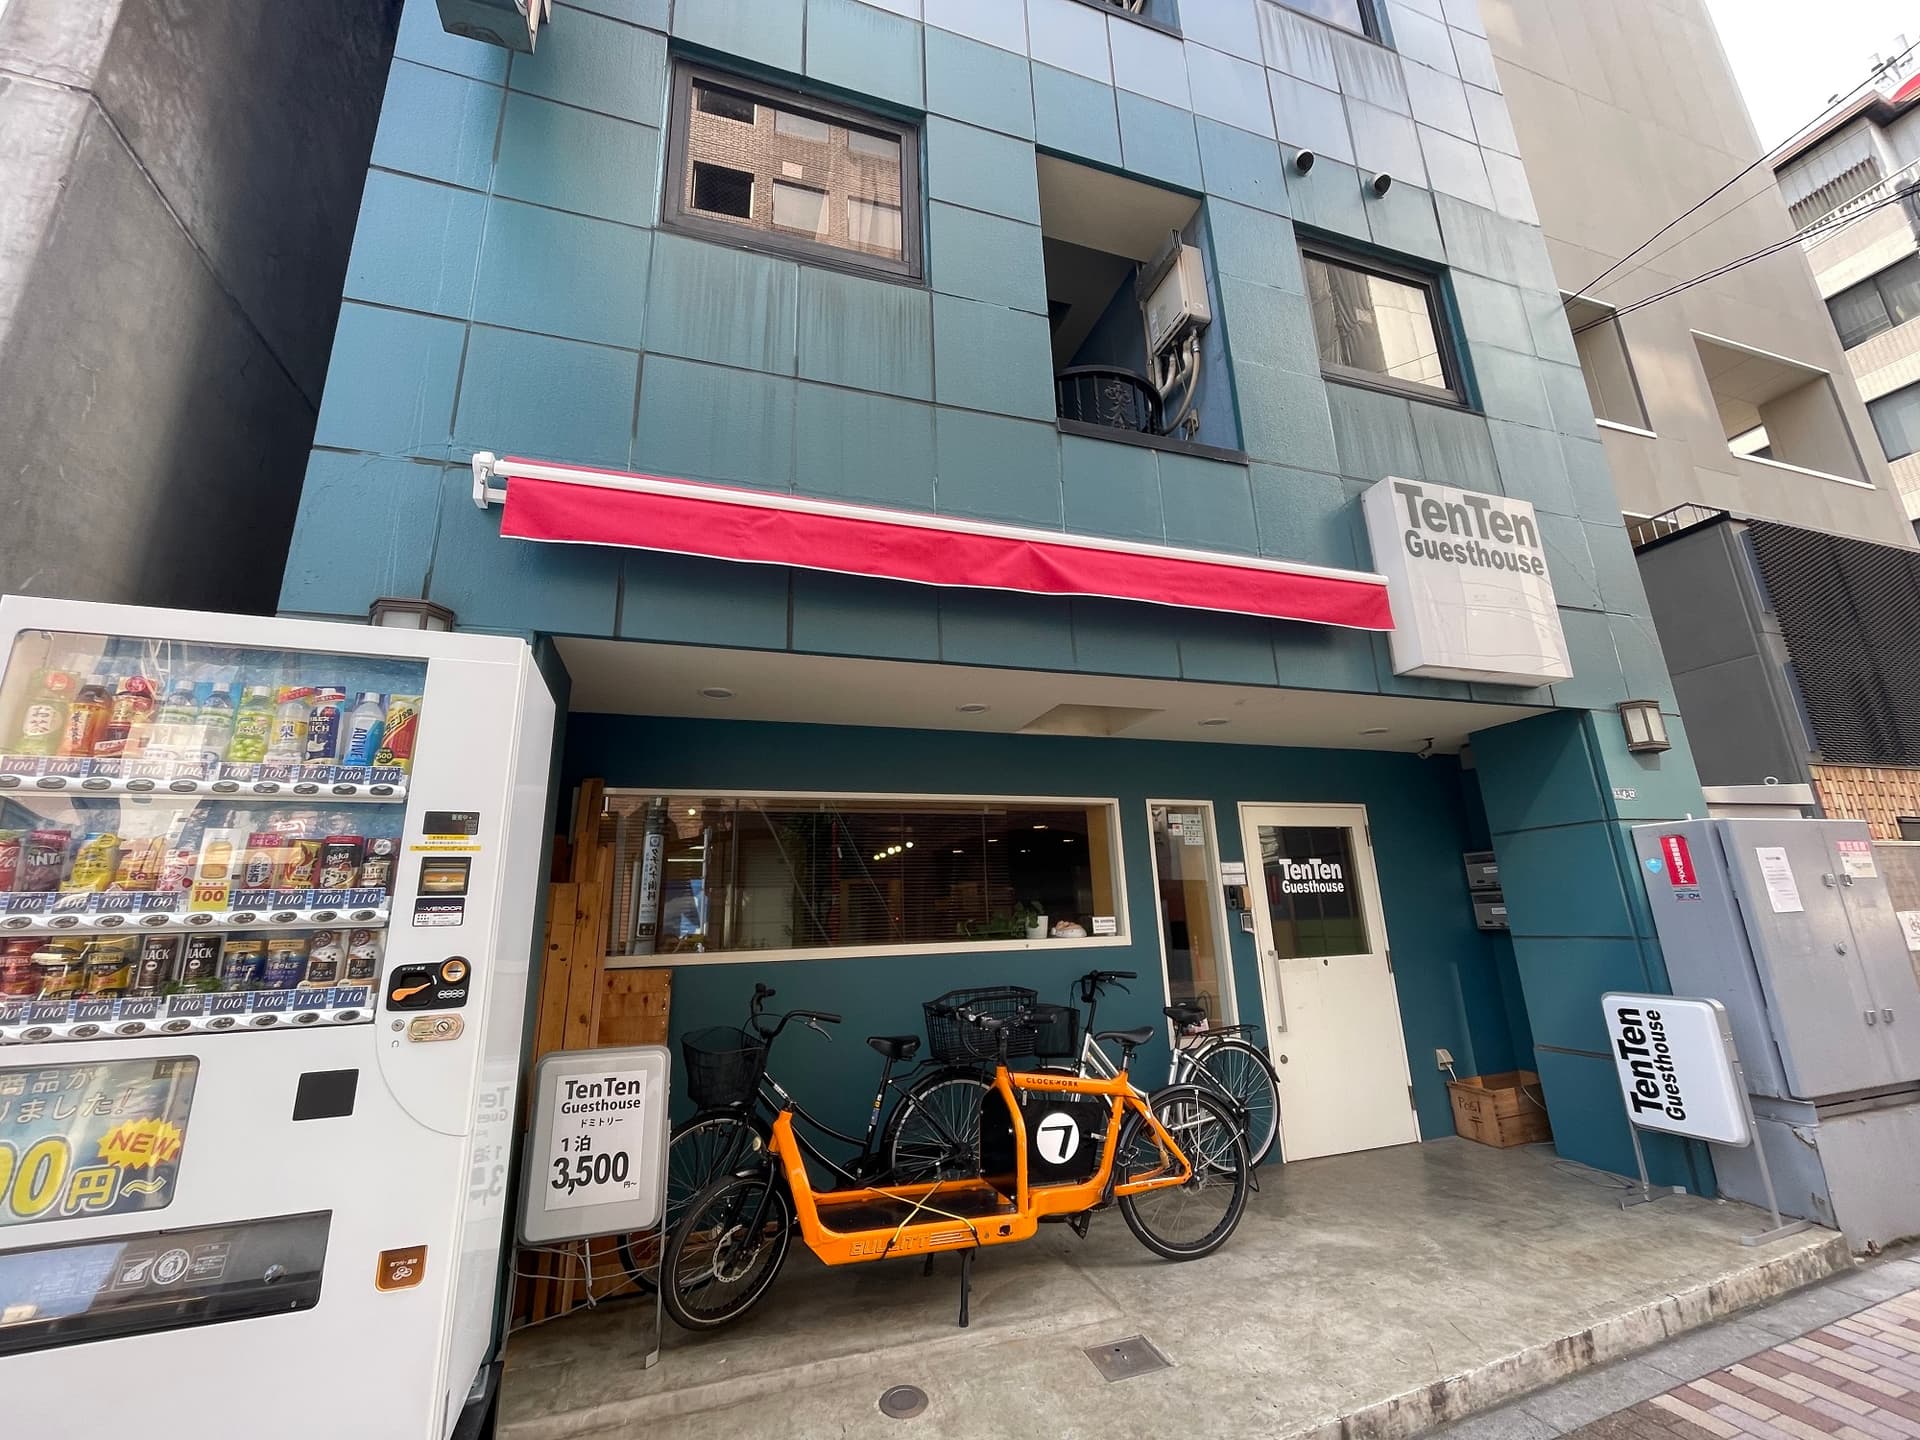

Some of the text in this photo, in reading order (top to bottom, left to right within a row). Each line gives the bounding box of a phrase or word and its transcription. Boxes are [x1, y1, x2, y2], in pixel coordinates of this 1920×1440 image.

[1394, 482, 1538, 548] TenTen
[1405, 530, 1545, 576] Guesthouse
[5, 761, 35, 771] 100
[48, 762, 78, 773] 100
[92, 763, 121, 774] 100
[223, 767, 250, 778] 100
[262, 768, 288, 779] 100
[301, 769, 327, 780] 110
[337, 770, 362, 781] 100
[373, 771, 398, 781] 110
[1279, 858, 1343, 880] TenTen
[1282, 880, 1345, 894] Guesthouse
[144, 895, 173, 908] 100
[194, 890, 224, 902] 100
[238, 895, 265, 905] 110
[277, 895, 303, 905] 100
[315, 894, 342, 905] 100
[352, 893, 377, 904] 110
[11, 898, 42, 910] 100
[101, 897, 130, 909] 100
[256, 996, 284, 1008] 100
[297, 994, 324, 1006] 110
[337, 991, 363, 1003] 110
[124, 1003, 153, 1015] 100
[173, 1000, 200, 1012] 100
[215, 998, 243, 1009] 100
[0, 1007, 18, 1019] 00
[33, 1006, 64, 1019] 100
[80, 1004, 109, 1017] 100
[1617, 1008, 1664, 1114] TenTen
[1646, 1009, 1687, 1121] Guesthouse
[561, 1099, 641, 1114] Guesthouse
[581, 1117, 623, 1128] ドミトリー
[107, 1128, 177, 1158] NEW
[1041, 1125, 1073, 1159] 7
